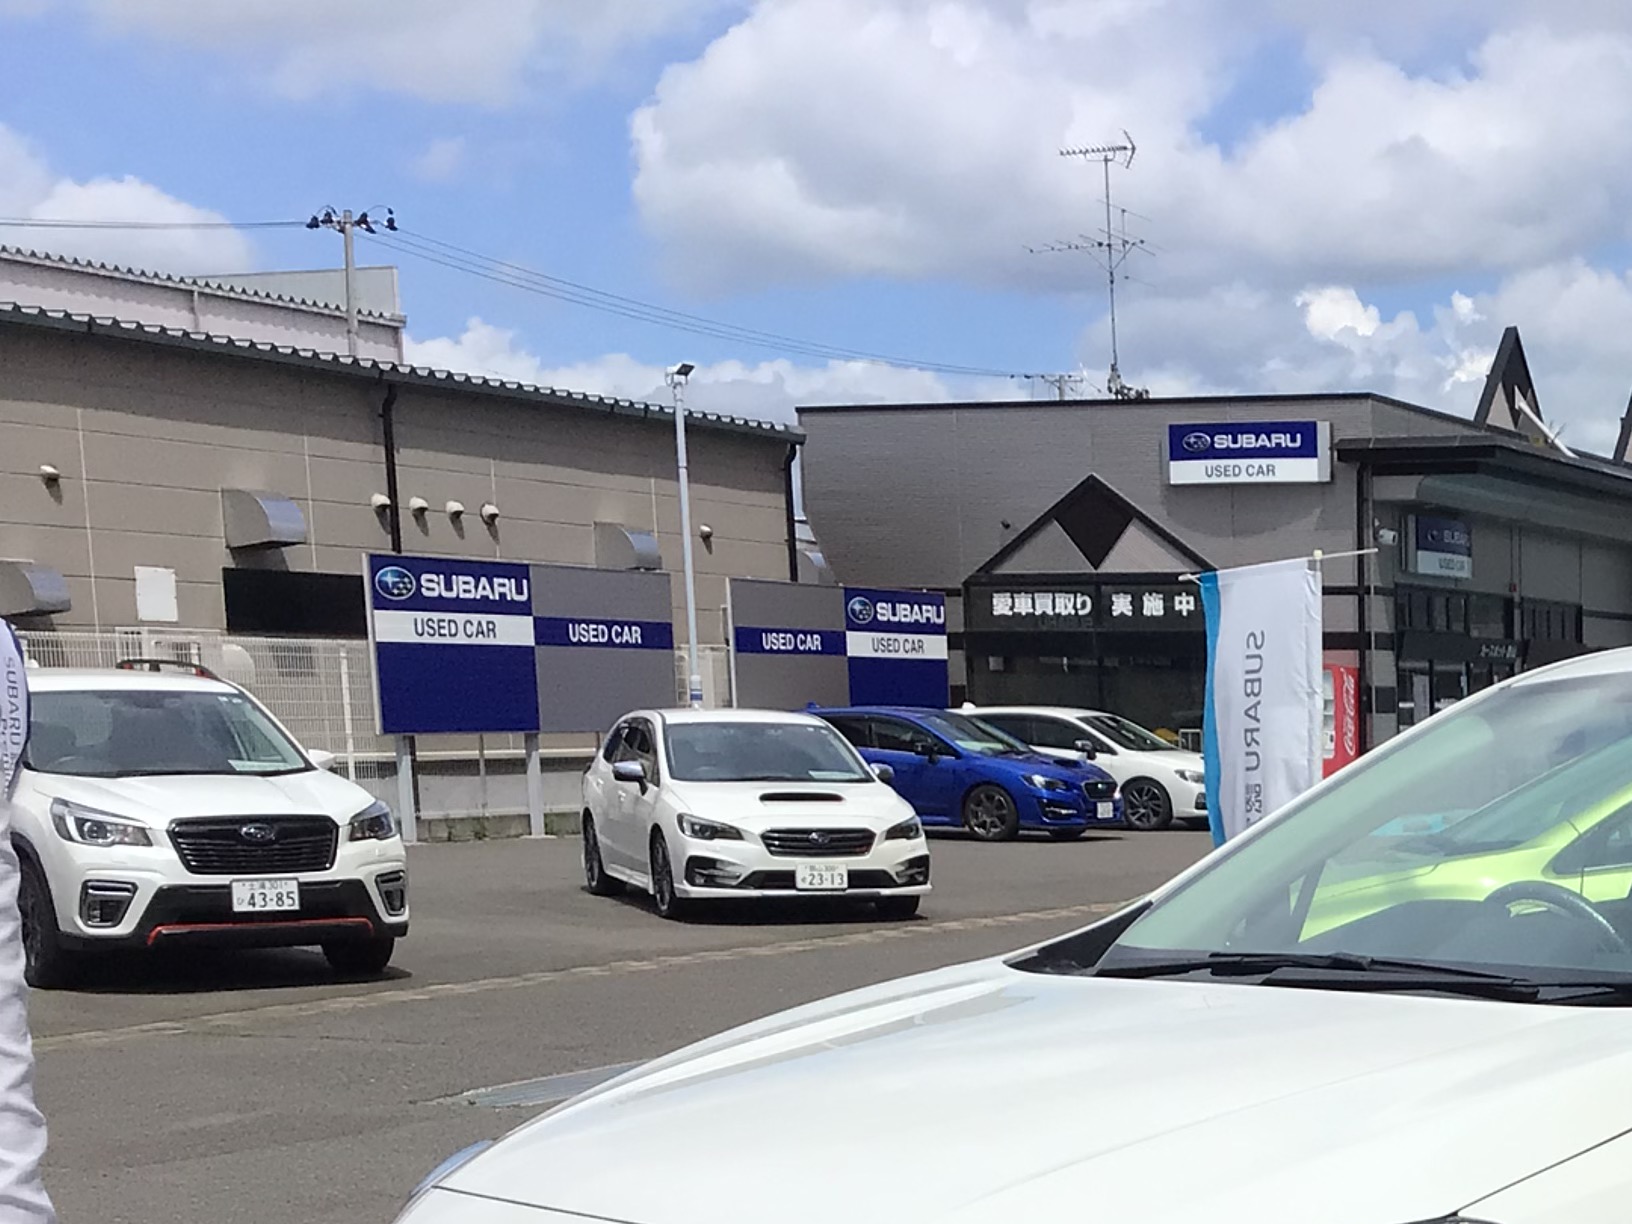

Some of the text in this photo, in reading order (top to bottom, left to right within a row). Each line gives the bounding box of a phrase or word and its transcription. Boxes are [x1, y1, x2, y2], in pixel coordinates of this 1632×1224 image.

[1214, 433, 1301, 448] SUBARU
[1205, 464, 1276, 477] USED CAR
[420, 573, 528, 602] SUBARU
[876, 602, 944, 624] SUBARU
[992, 592, 1195, 617] 愛車買取り 実施中
[414, 618, 497, 639] USED CAR
[568, 624, 642, 644] USED CAR
[762, 633, 821, 651] USED CAR
[872, 637, 925, 654] USED CAR
[6, 657, 21, 746] SUBARU
[1340, 668, 1356, 757] Coca-Cola
[808, 873, 844, 885] 23-13
[247, 891, 295, 908] 43-85
